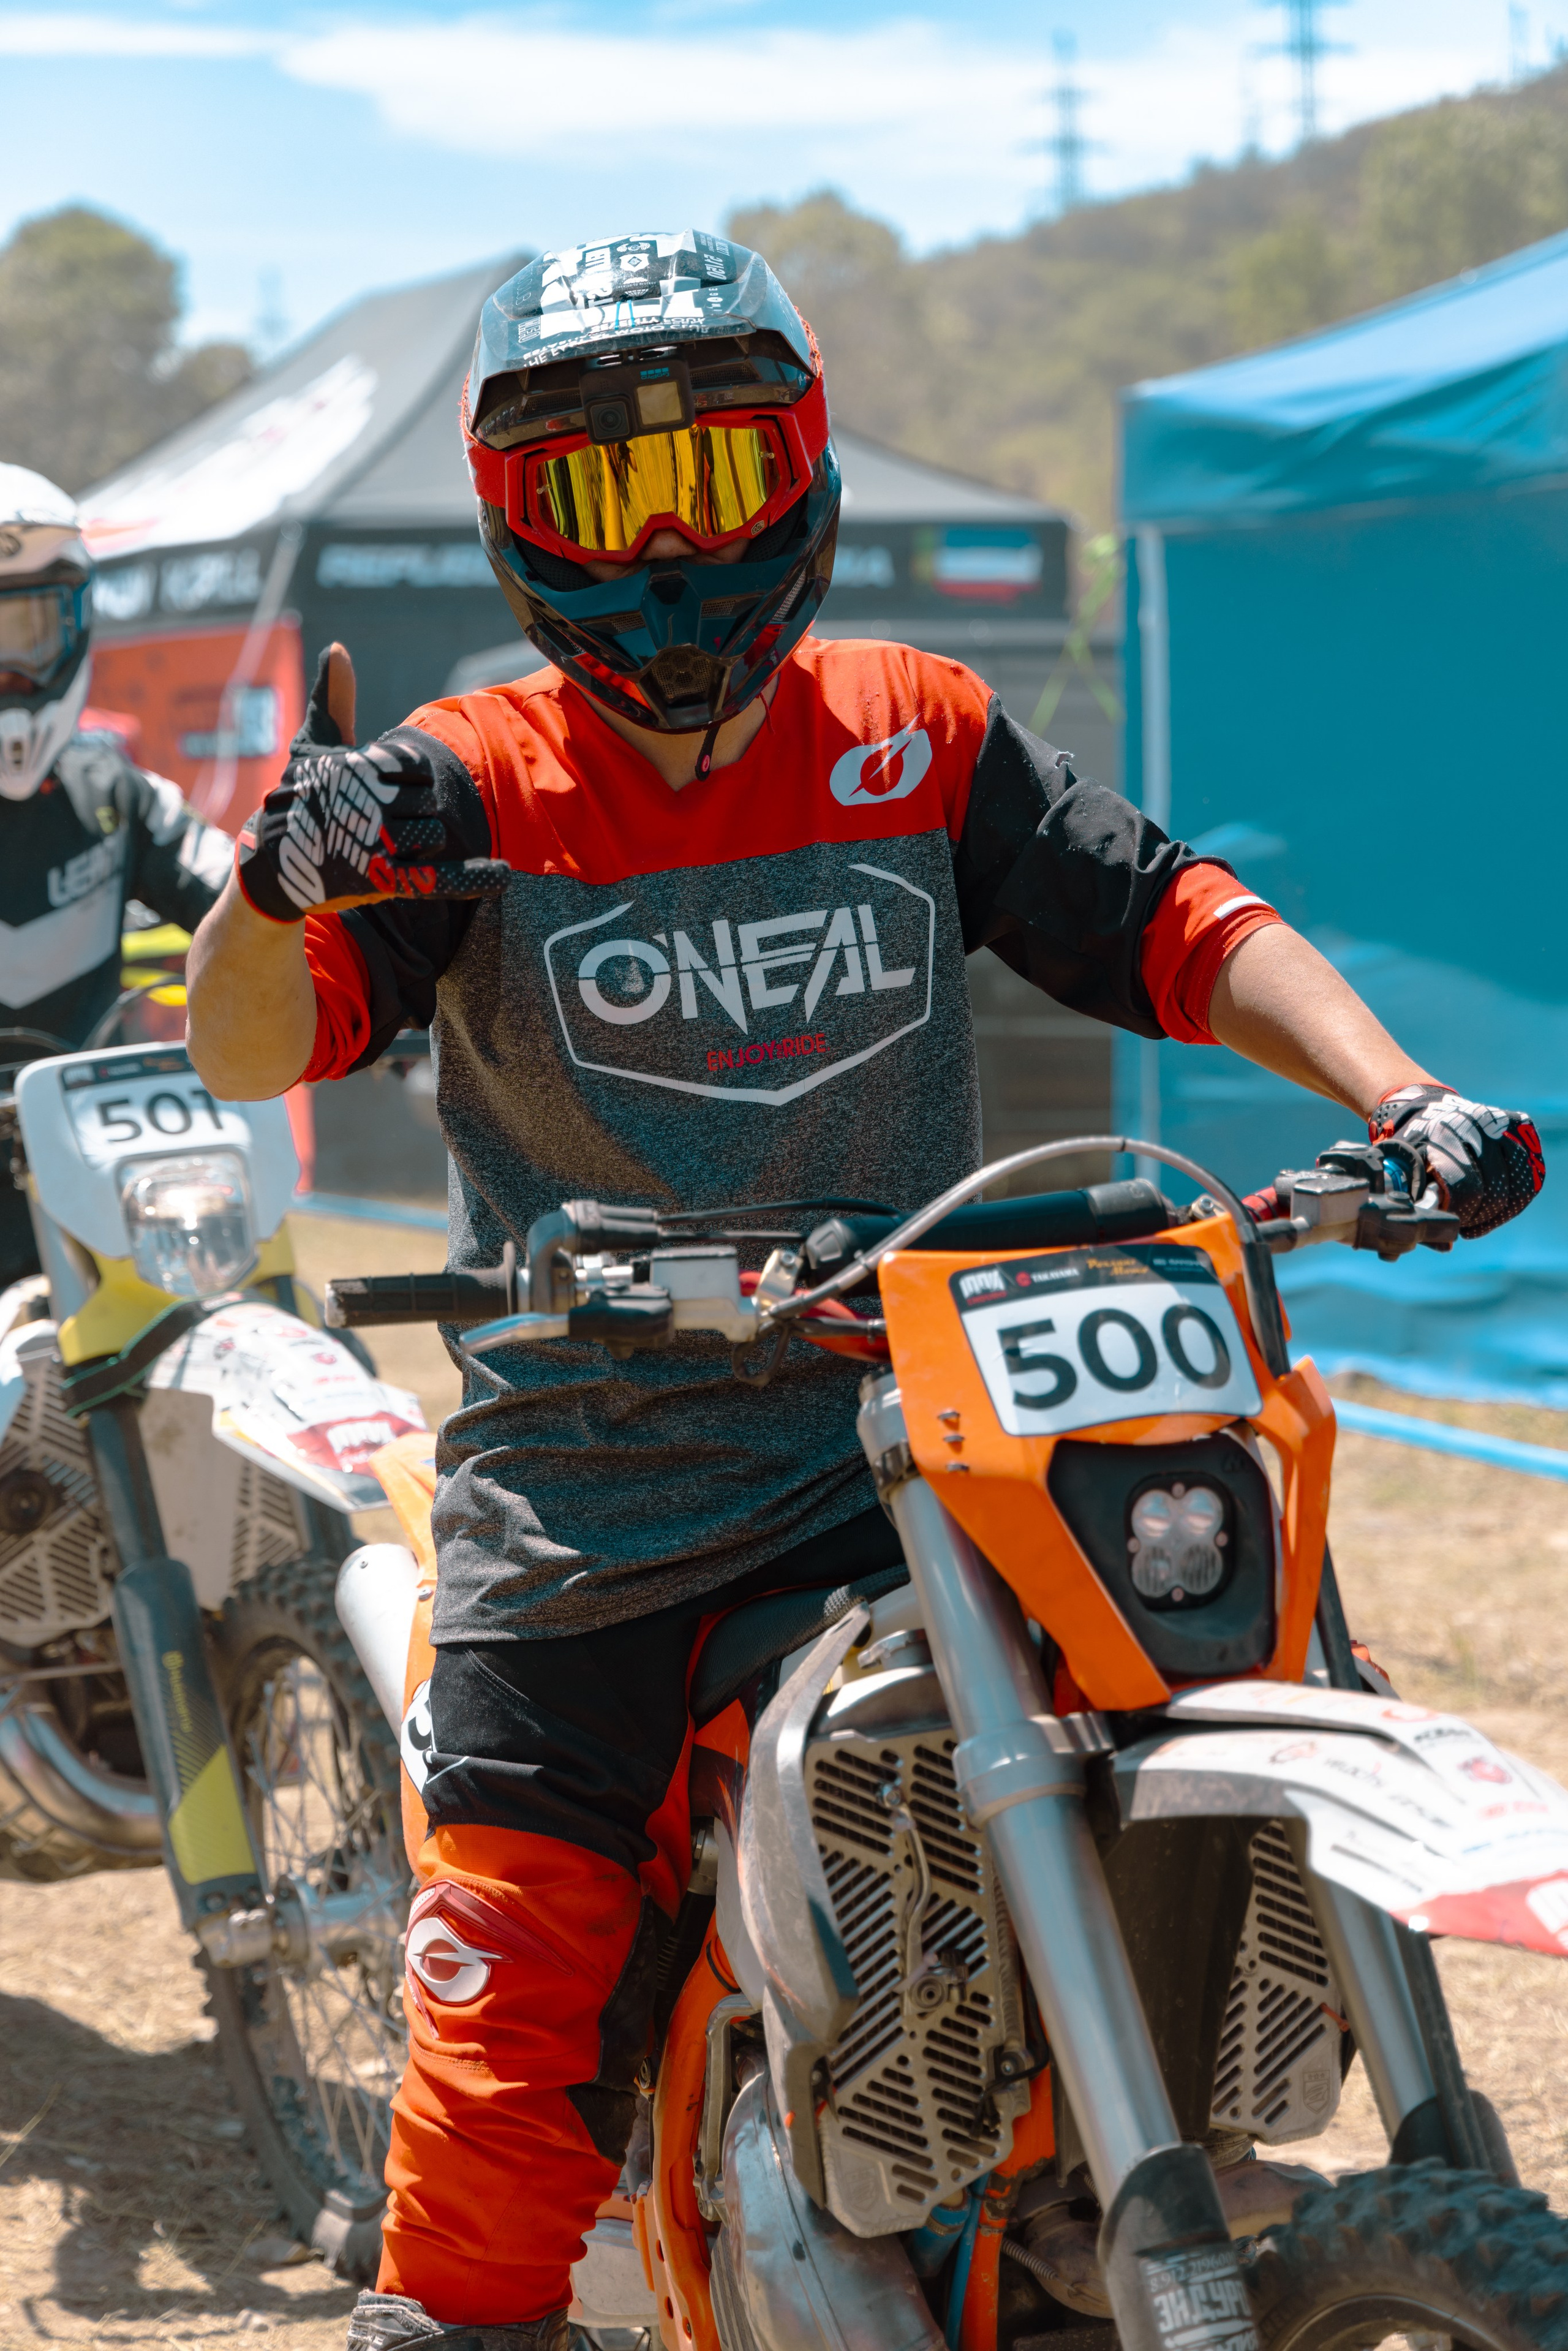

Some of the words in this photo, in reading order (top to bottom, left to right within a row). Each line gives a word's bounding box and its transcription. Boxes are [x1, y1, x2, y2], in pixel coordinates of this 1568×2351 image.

[641, 372, 669, 380] GoPro
[752, 521, 764, 535] 100%
[707, 1041, 776, 1071] ENJOY
[97, 1085, 224, 1144] 501
[997, 1304, 1231, 1411] 500
